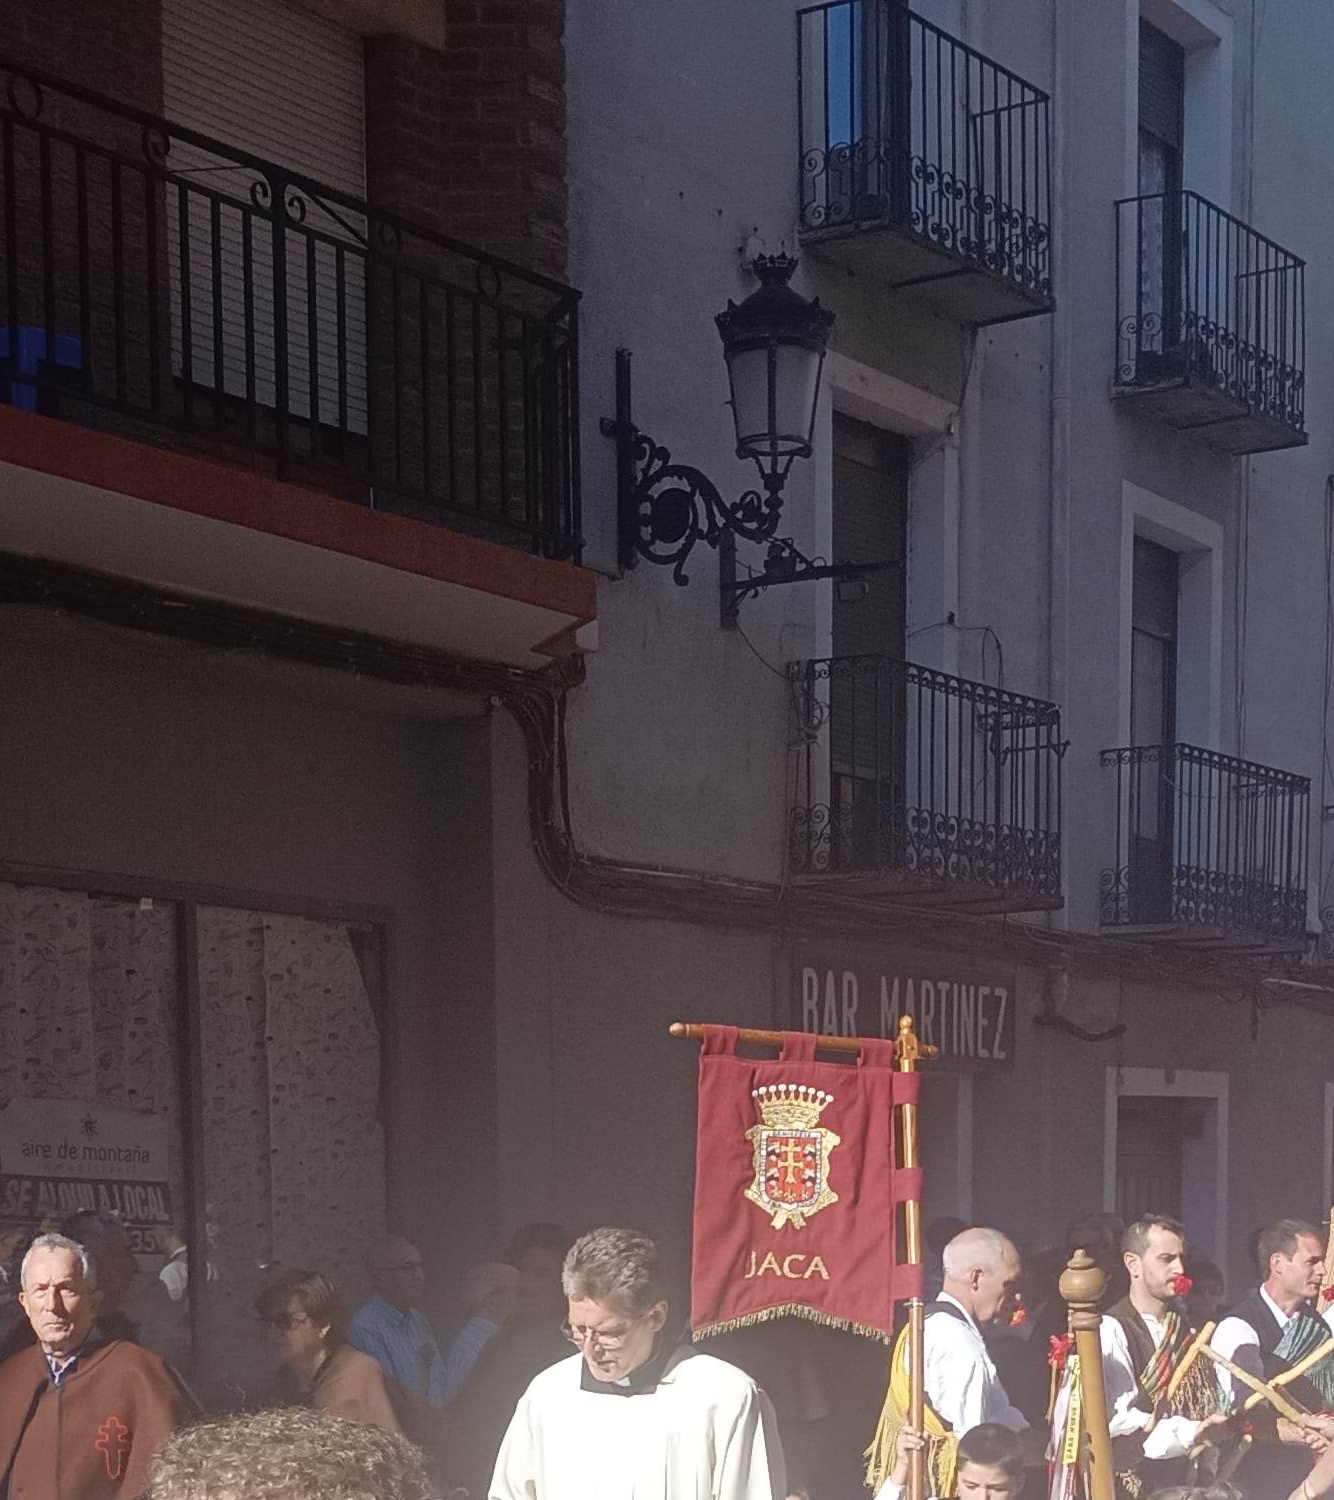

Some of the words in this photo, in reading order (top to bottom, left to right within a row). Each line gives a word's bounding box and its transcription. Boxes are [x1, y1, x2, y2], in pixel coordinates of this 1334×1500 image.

[802, 967, 859, 1038] BAR
[880, 975, 1008, 1060] MARTINEZ
[21, 1139, 52, 1158] aire
[57, 1140, 78, 1160] de
[82, 1144, 150, 1164] montaña
[4, 1179, 33, 1214] SE
[745, 1248, 831, 1281] JACA
